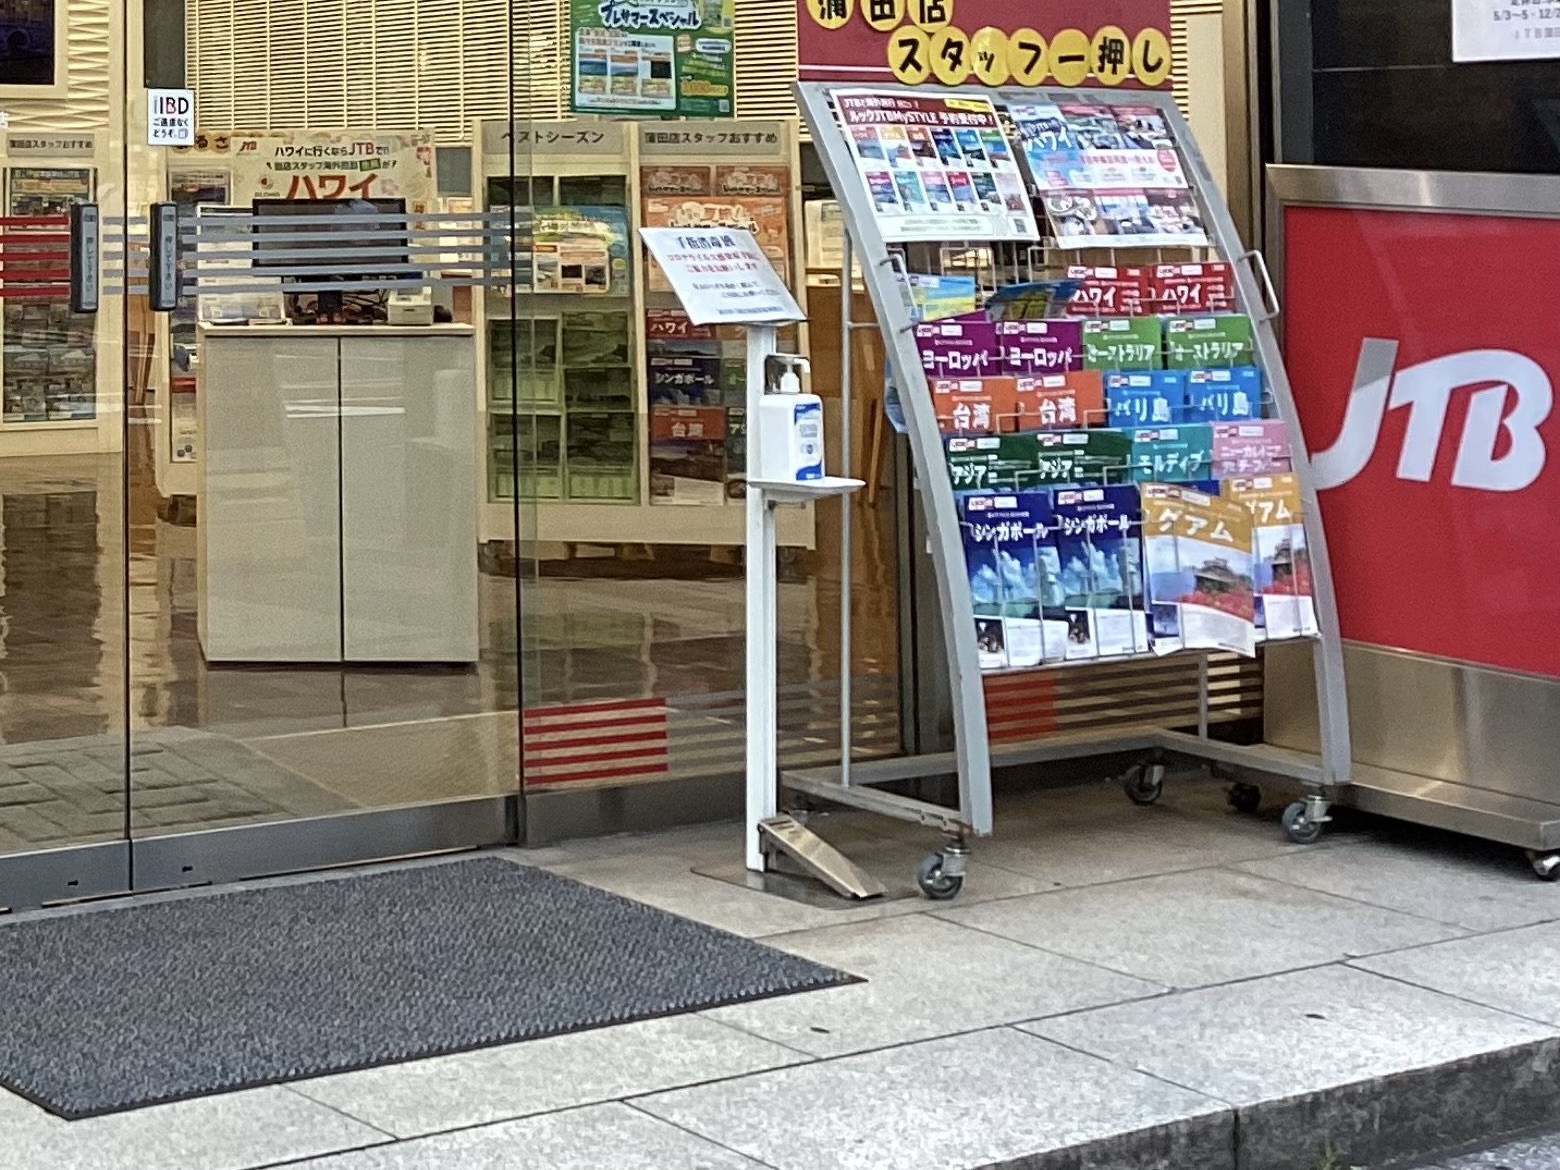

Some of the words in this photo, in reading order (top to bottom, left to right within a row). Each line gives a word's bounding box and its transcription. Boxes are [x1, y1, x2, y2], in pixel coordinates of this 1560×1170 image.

[897, 36, 1164, 75] スタッフ一押し
[921, 349, 989, 370] ヨーロッパ
[1009, 346, 1073, 367] ヨーロッパ
[1312, 337, 1554, 492] JTB
[1159, 508, 1234, 543] グアム
